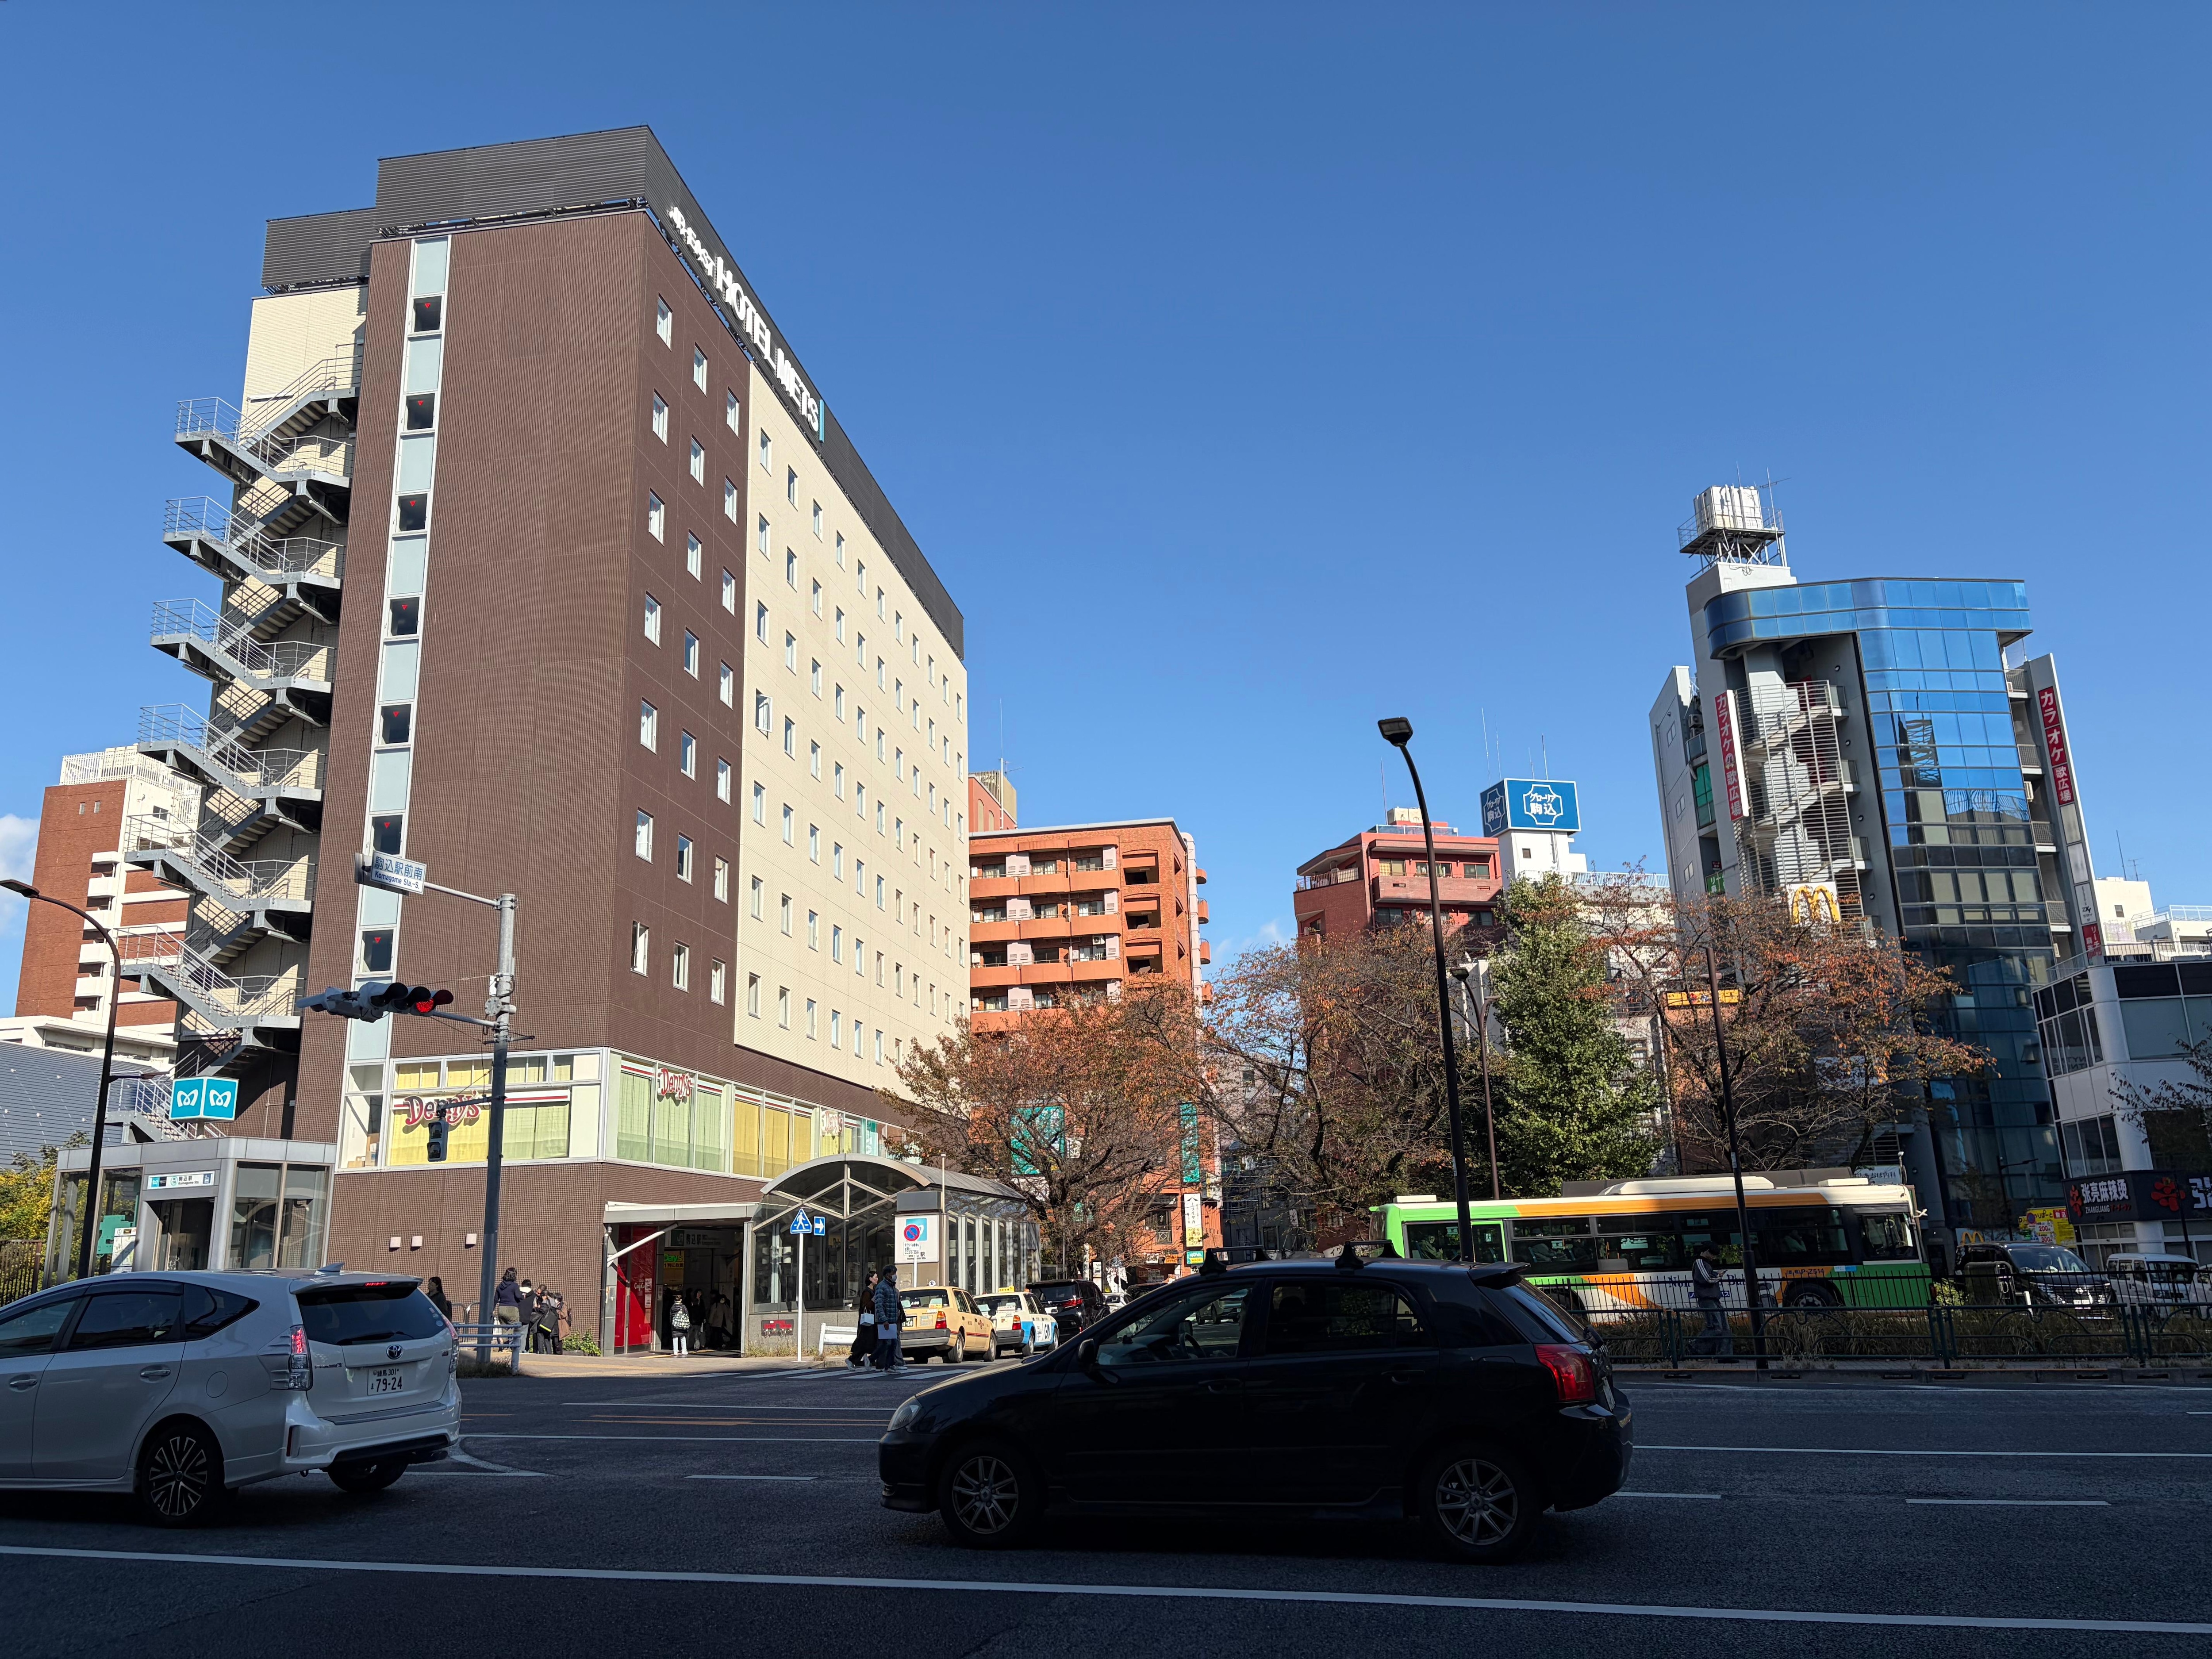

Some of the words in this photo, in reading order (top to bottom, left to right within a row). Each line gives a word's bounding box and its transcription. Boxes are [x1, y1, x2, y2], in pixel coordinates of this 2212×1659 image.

[716, 256, 776, 370] HOTEL
[777, 348, 818, 432] METS
[2040, 691, 2064, 762] カラオケ
[2055, 766, 2072, 802] 歌広場
[1717, 695, 1732, 751] カラオケ
[1726, 770, 1742, 816] 歌広場
[1486, 797, 1501, 810] グローリア
[1530, 792, 1556, 803] グローリア
[1487, 806, 1502, 823] 駒込
[1530, 803, 1557, 815] 駒込
[375, 856, 423, 880] 駒込駅前南
[375, 871, 402, 884] Komagome
[661, 1068, 691, 1099] Denny's
[2081, 1179, 2129, 1204] 张亮麻辣烫
[2085, 1205, 2110, 1214] ZHANGLIANG
[376, 1376, 402, 1392] 79-24
